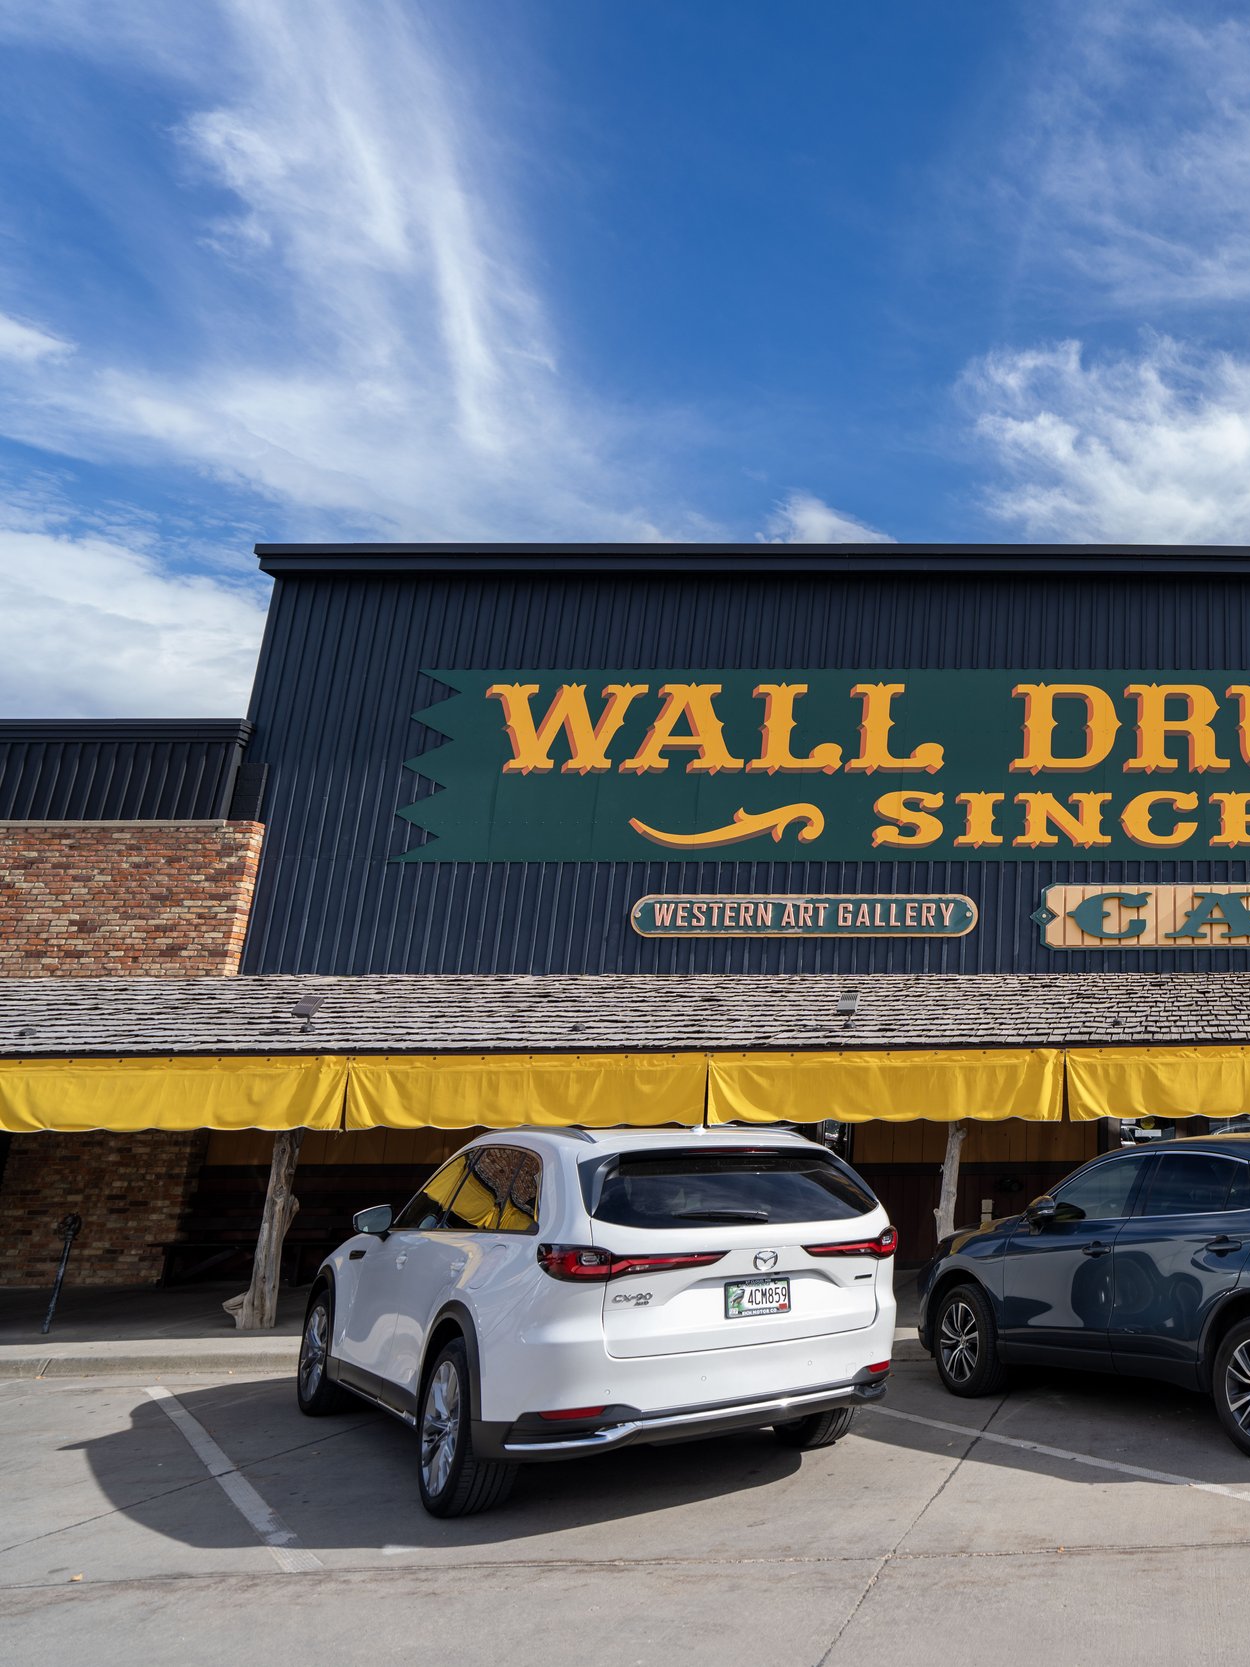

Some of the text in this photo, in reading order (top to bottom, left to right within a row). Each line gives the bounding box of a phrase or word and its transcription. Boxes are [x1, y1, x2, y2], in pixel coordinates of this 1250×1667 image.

[486, 682, 945, 776] WALL
[653, 902, 956, 928] WESTERN ART GALLERY
[611, 1292, 653, 1303] CX-90
[747, 1286, 787, 1306] 4CM859
